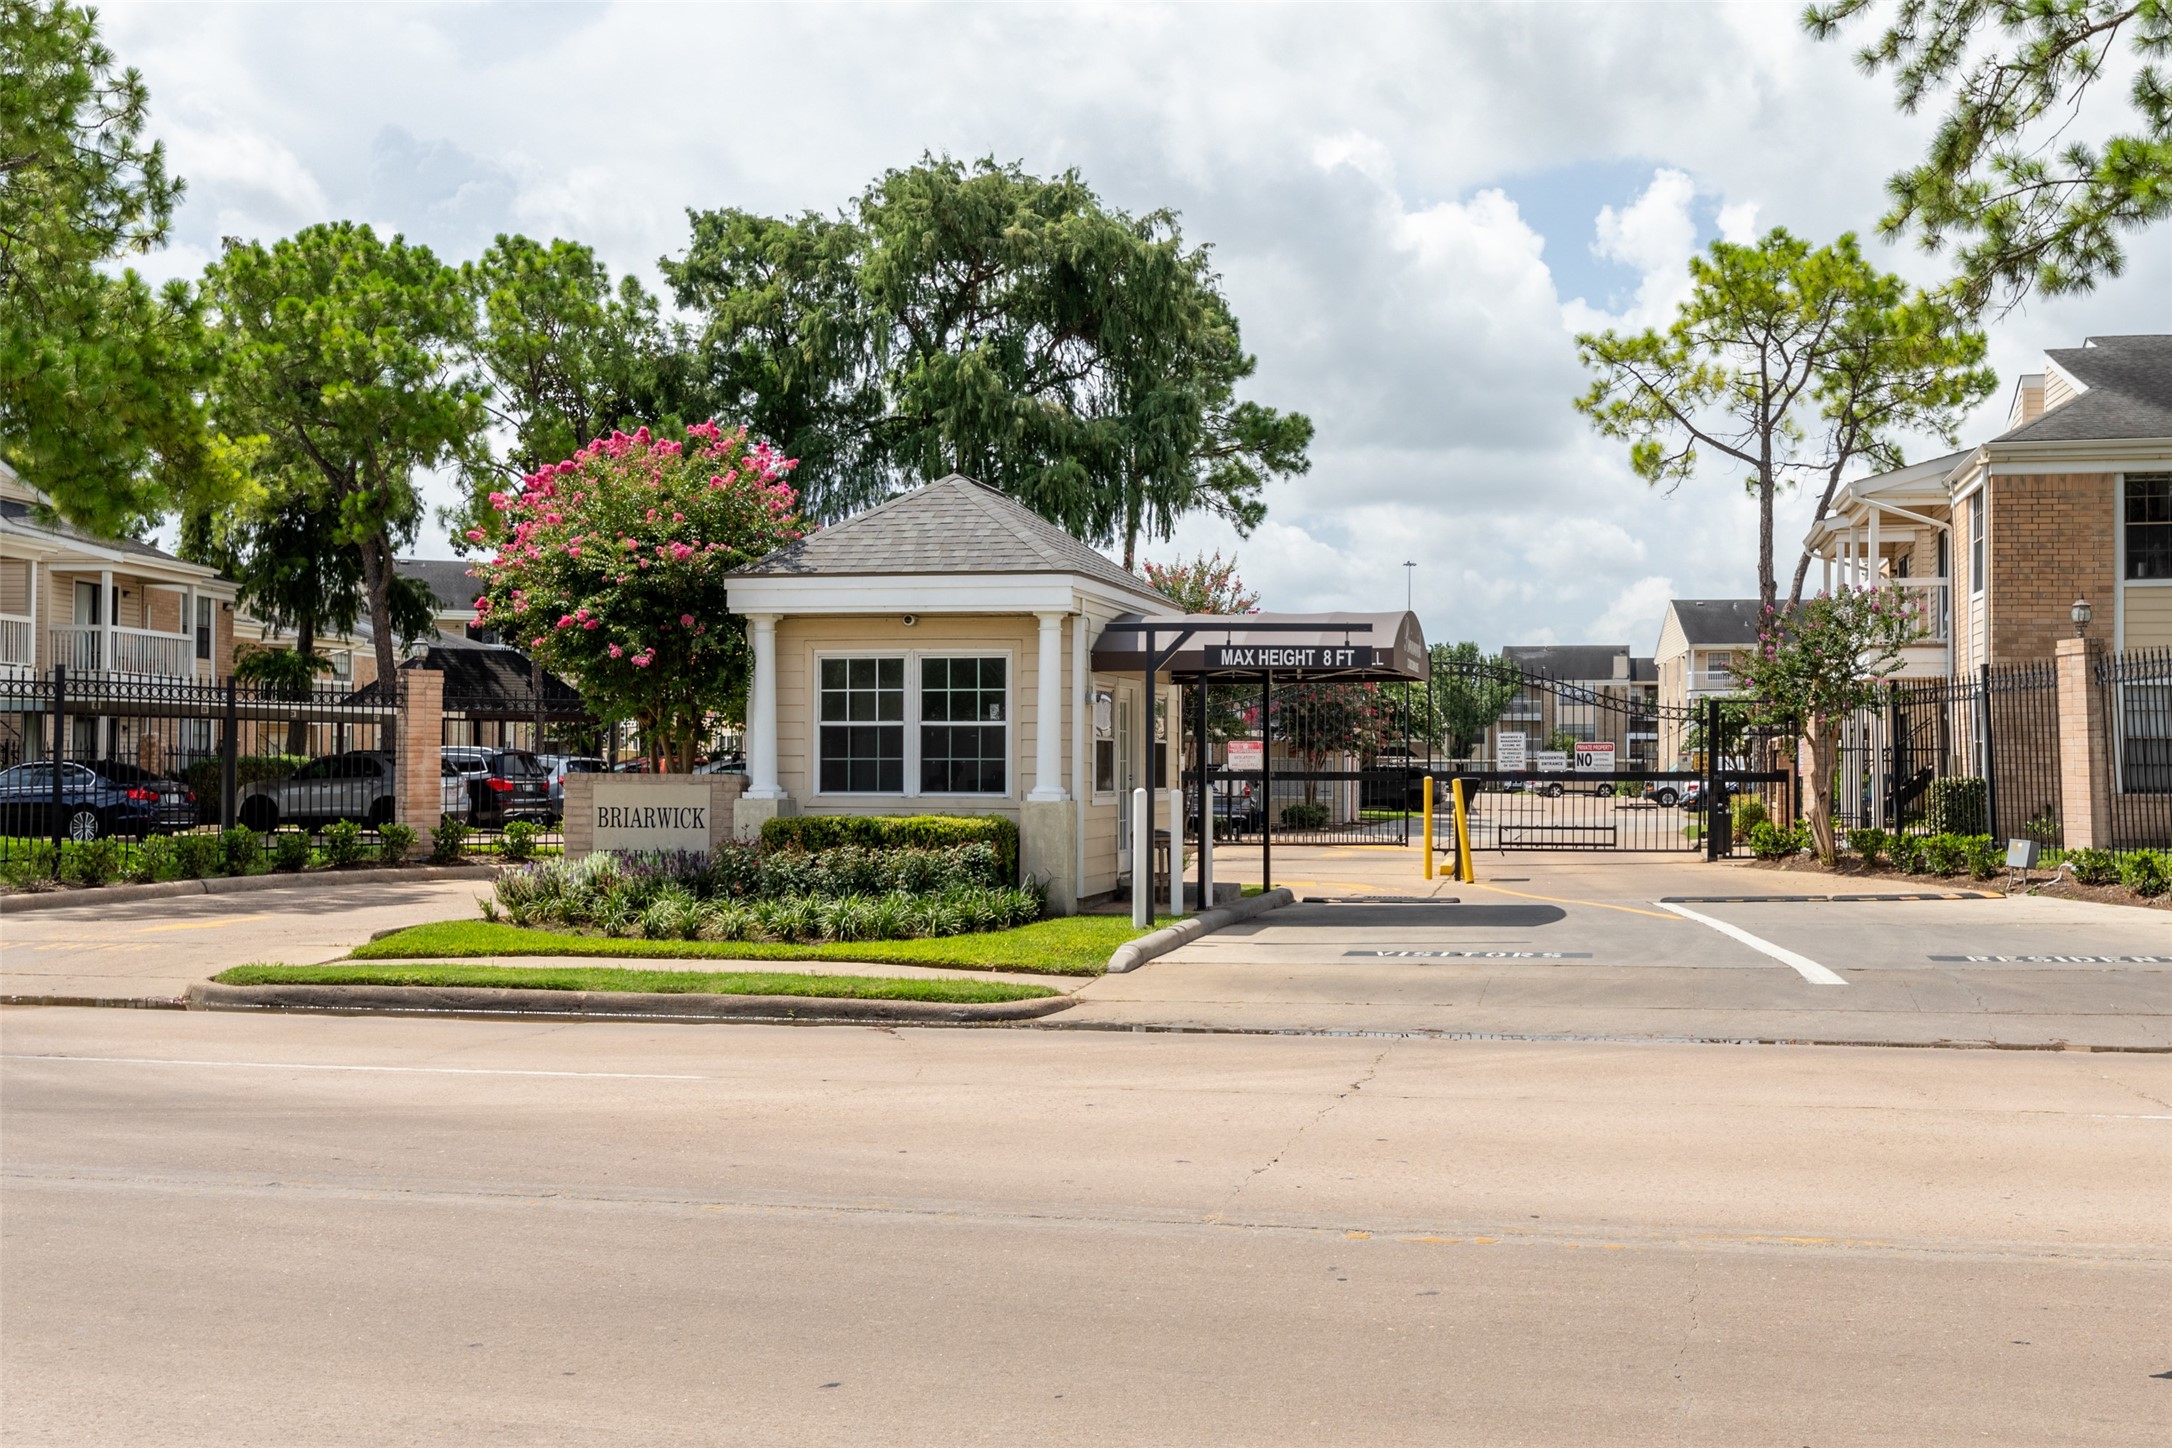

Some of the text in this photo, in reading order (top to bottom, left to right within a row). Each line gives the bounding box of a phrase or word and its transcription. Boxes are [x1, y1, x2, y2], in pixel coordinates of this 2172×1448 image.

[1221, 649, 1355, 667] MAX HEIGHT 8 FT
[1577, 752, 1592, 767] NO
[597, 806, 706, 829] BRIARWICK
